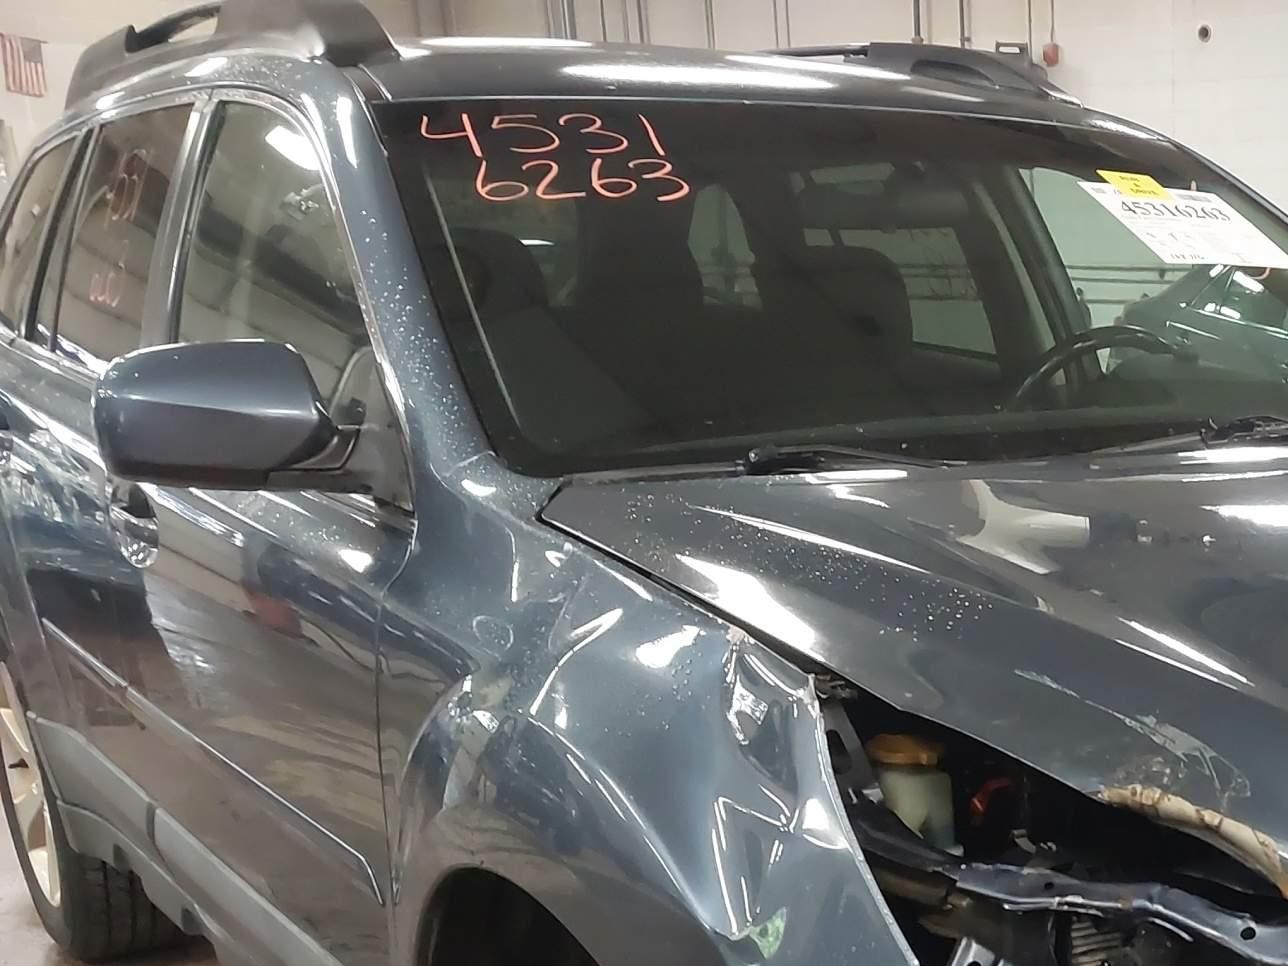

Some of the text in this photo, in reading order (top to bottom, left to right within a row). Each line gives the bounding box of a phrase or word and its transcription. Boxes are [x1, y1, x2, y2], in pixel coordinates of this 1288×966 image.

[420, 113, 666, 158] 4531
[475, 158, 691, 201] 6263
[1121, 200, 1231, 222] 45316263
